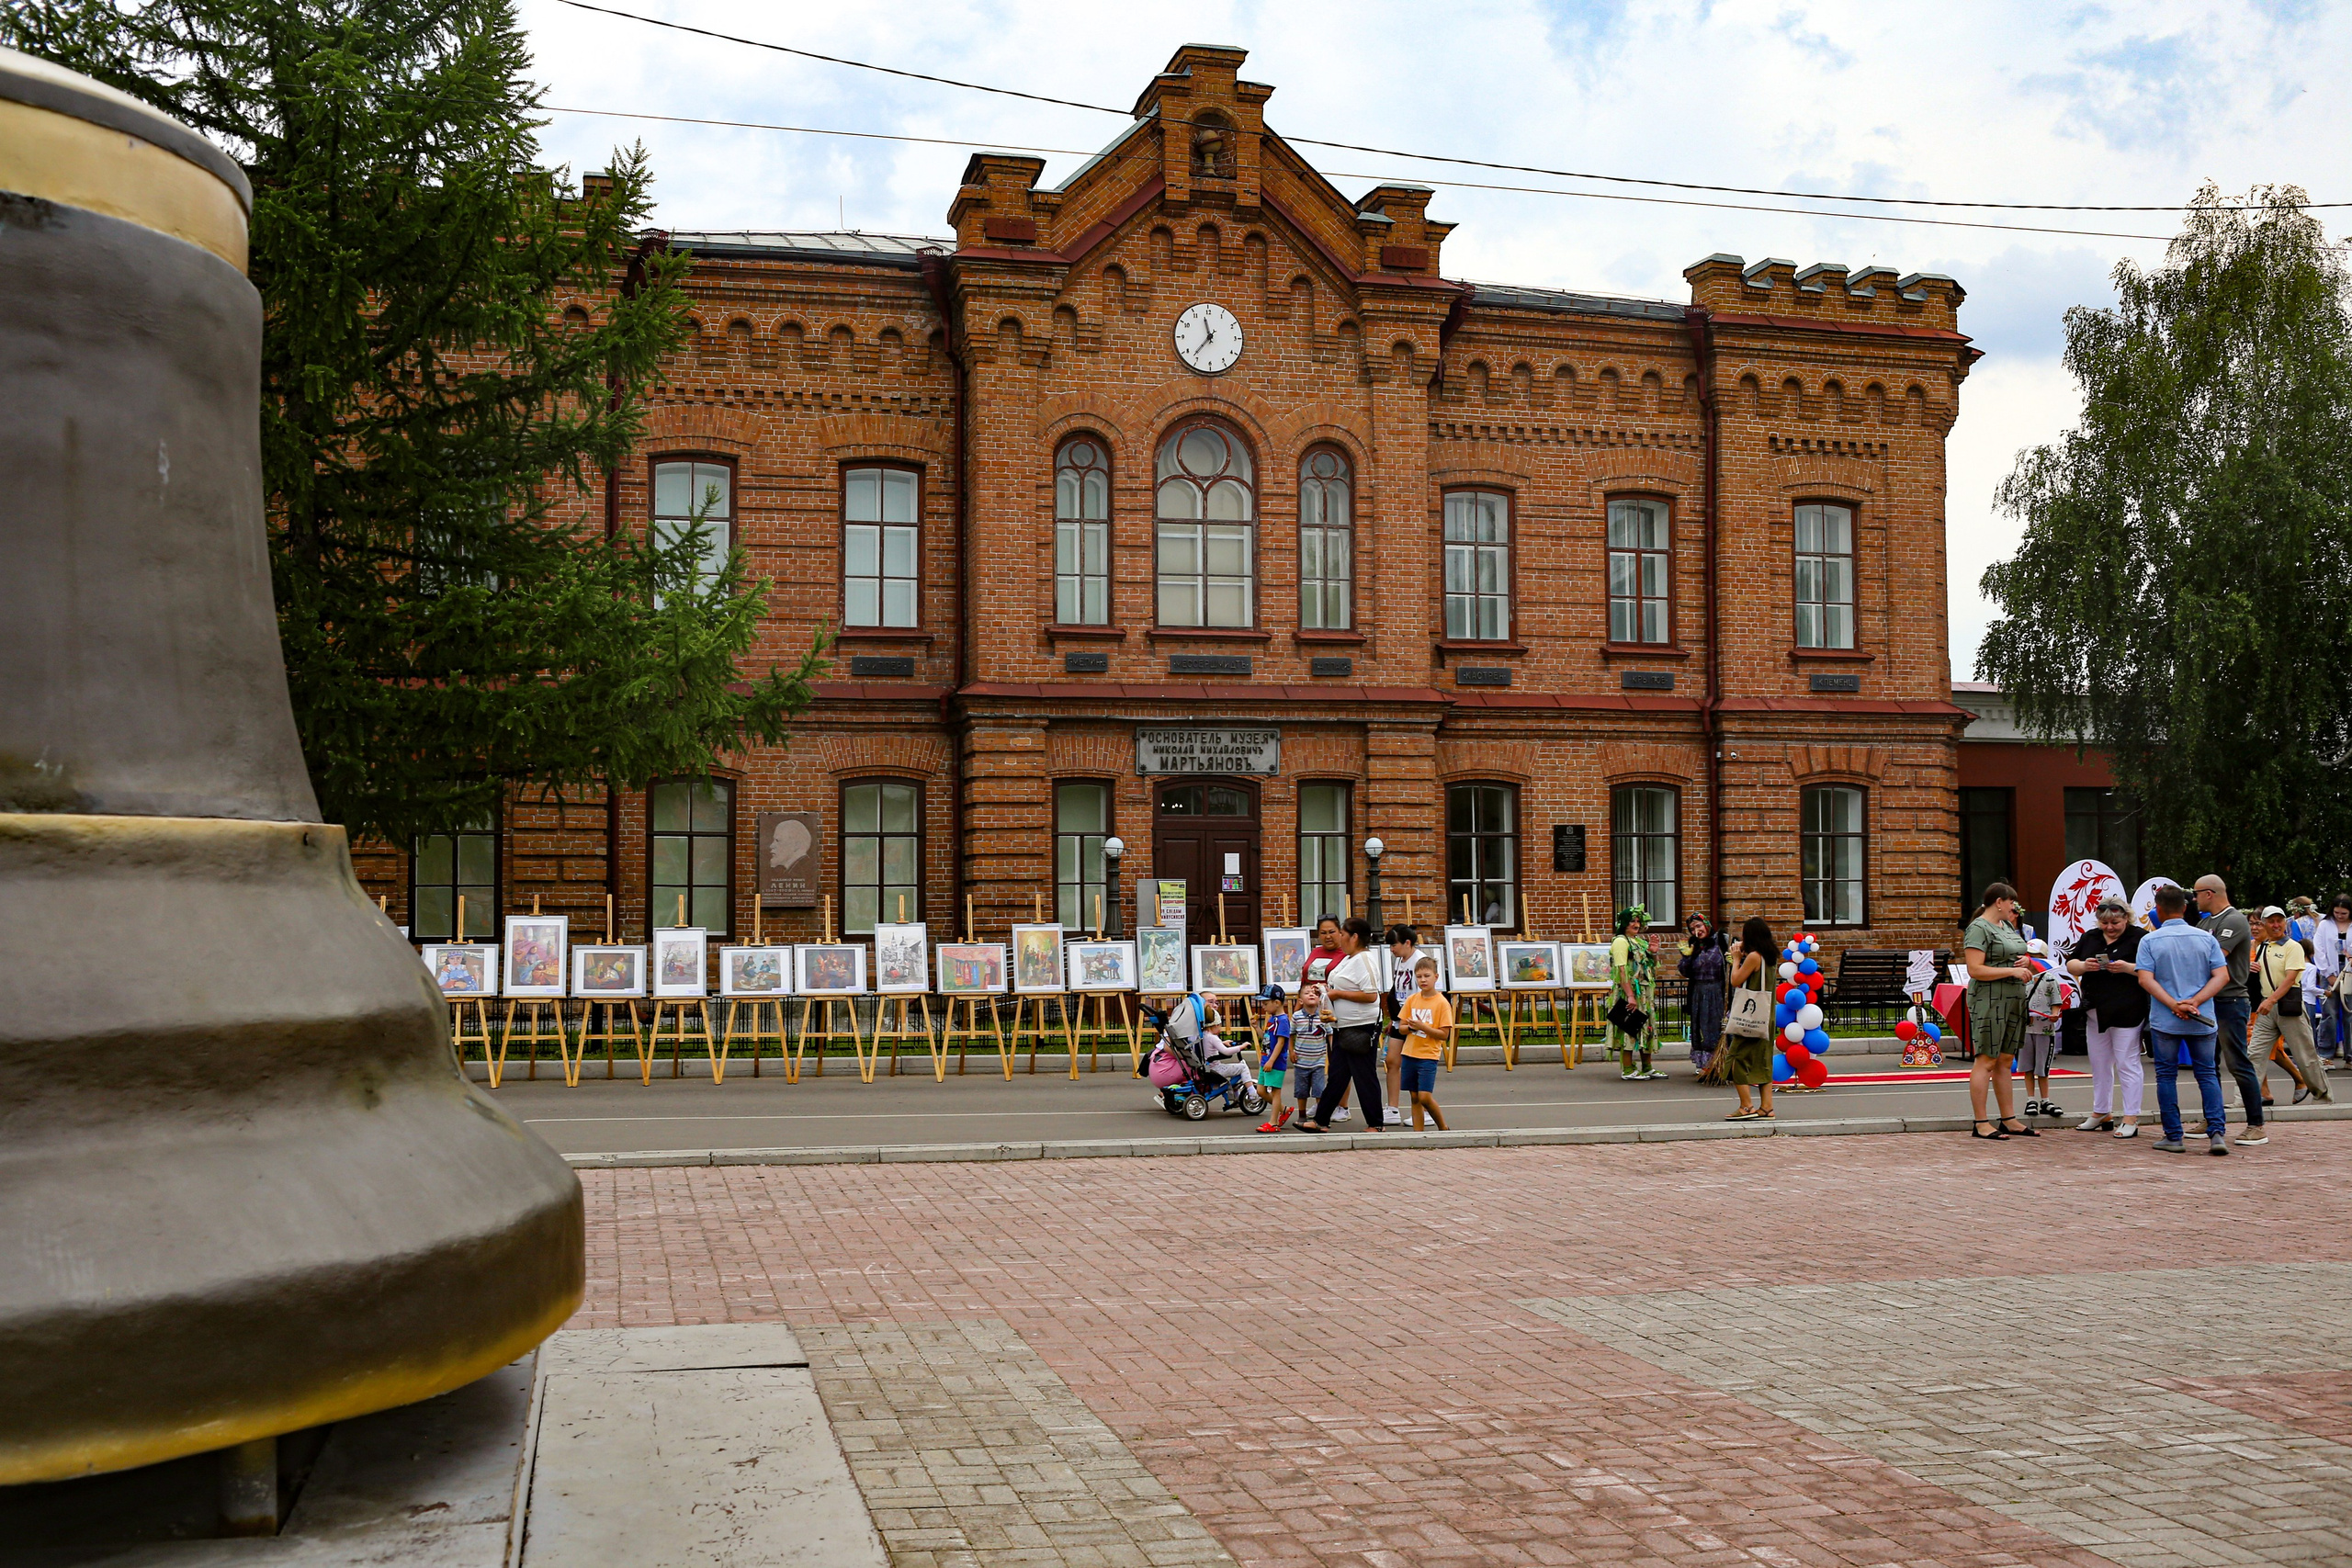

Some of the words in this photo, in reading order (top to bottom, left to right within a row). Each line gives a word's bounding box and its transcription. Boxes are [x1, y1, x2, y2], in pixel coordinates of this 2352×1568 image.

[1148, 731, 1222, 744] ОСНОВАТЕЛЬ
[1230, 732, 1269, 745] МУЗЕЯ
[1152, 744, 1194, 755] НИКОЛАЙ
[1200, 745, 1264, 755] МИХАЙЛОВИЧЪ
[1159, 756, 1256, 772] МАРТЬЯНОВЪ.
